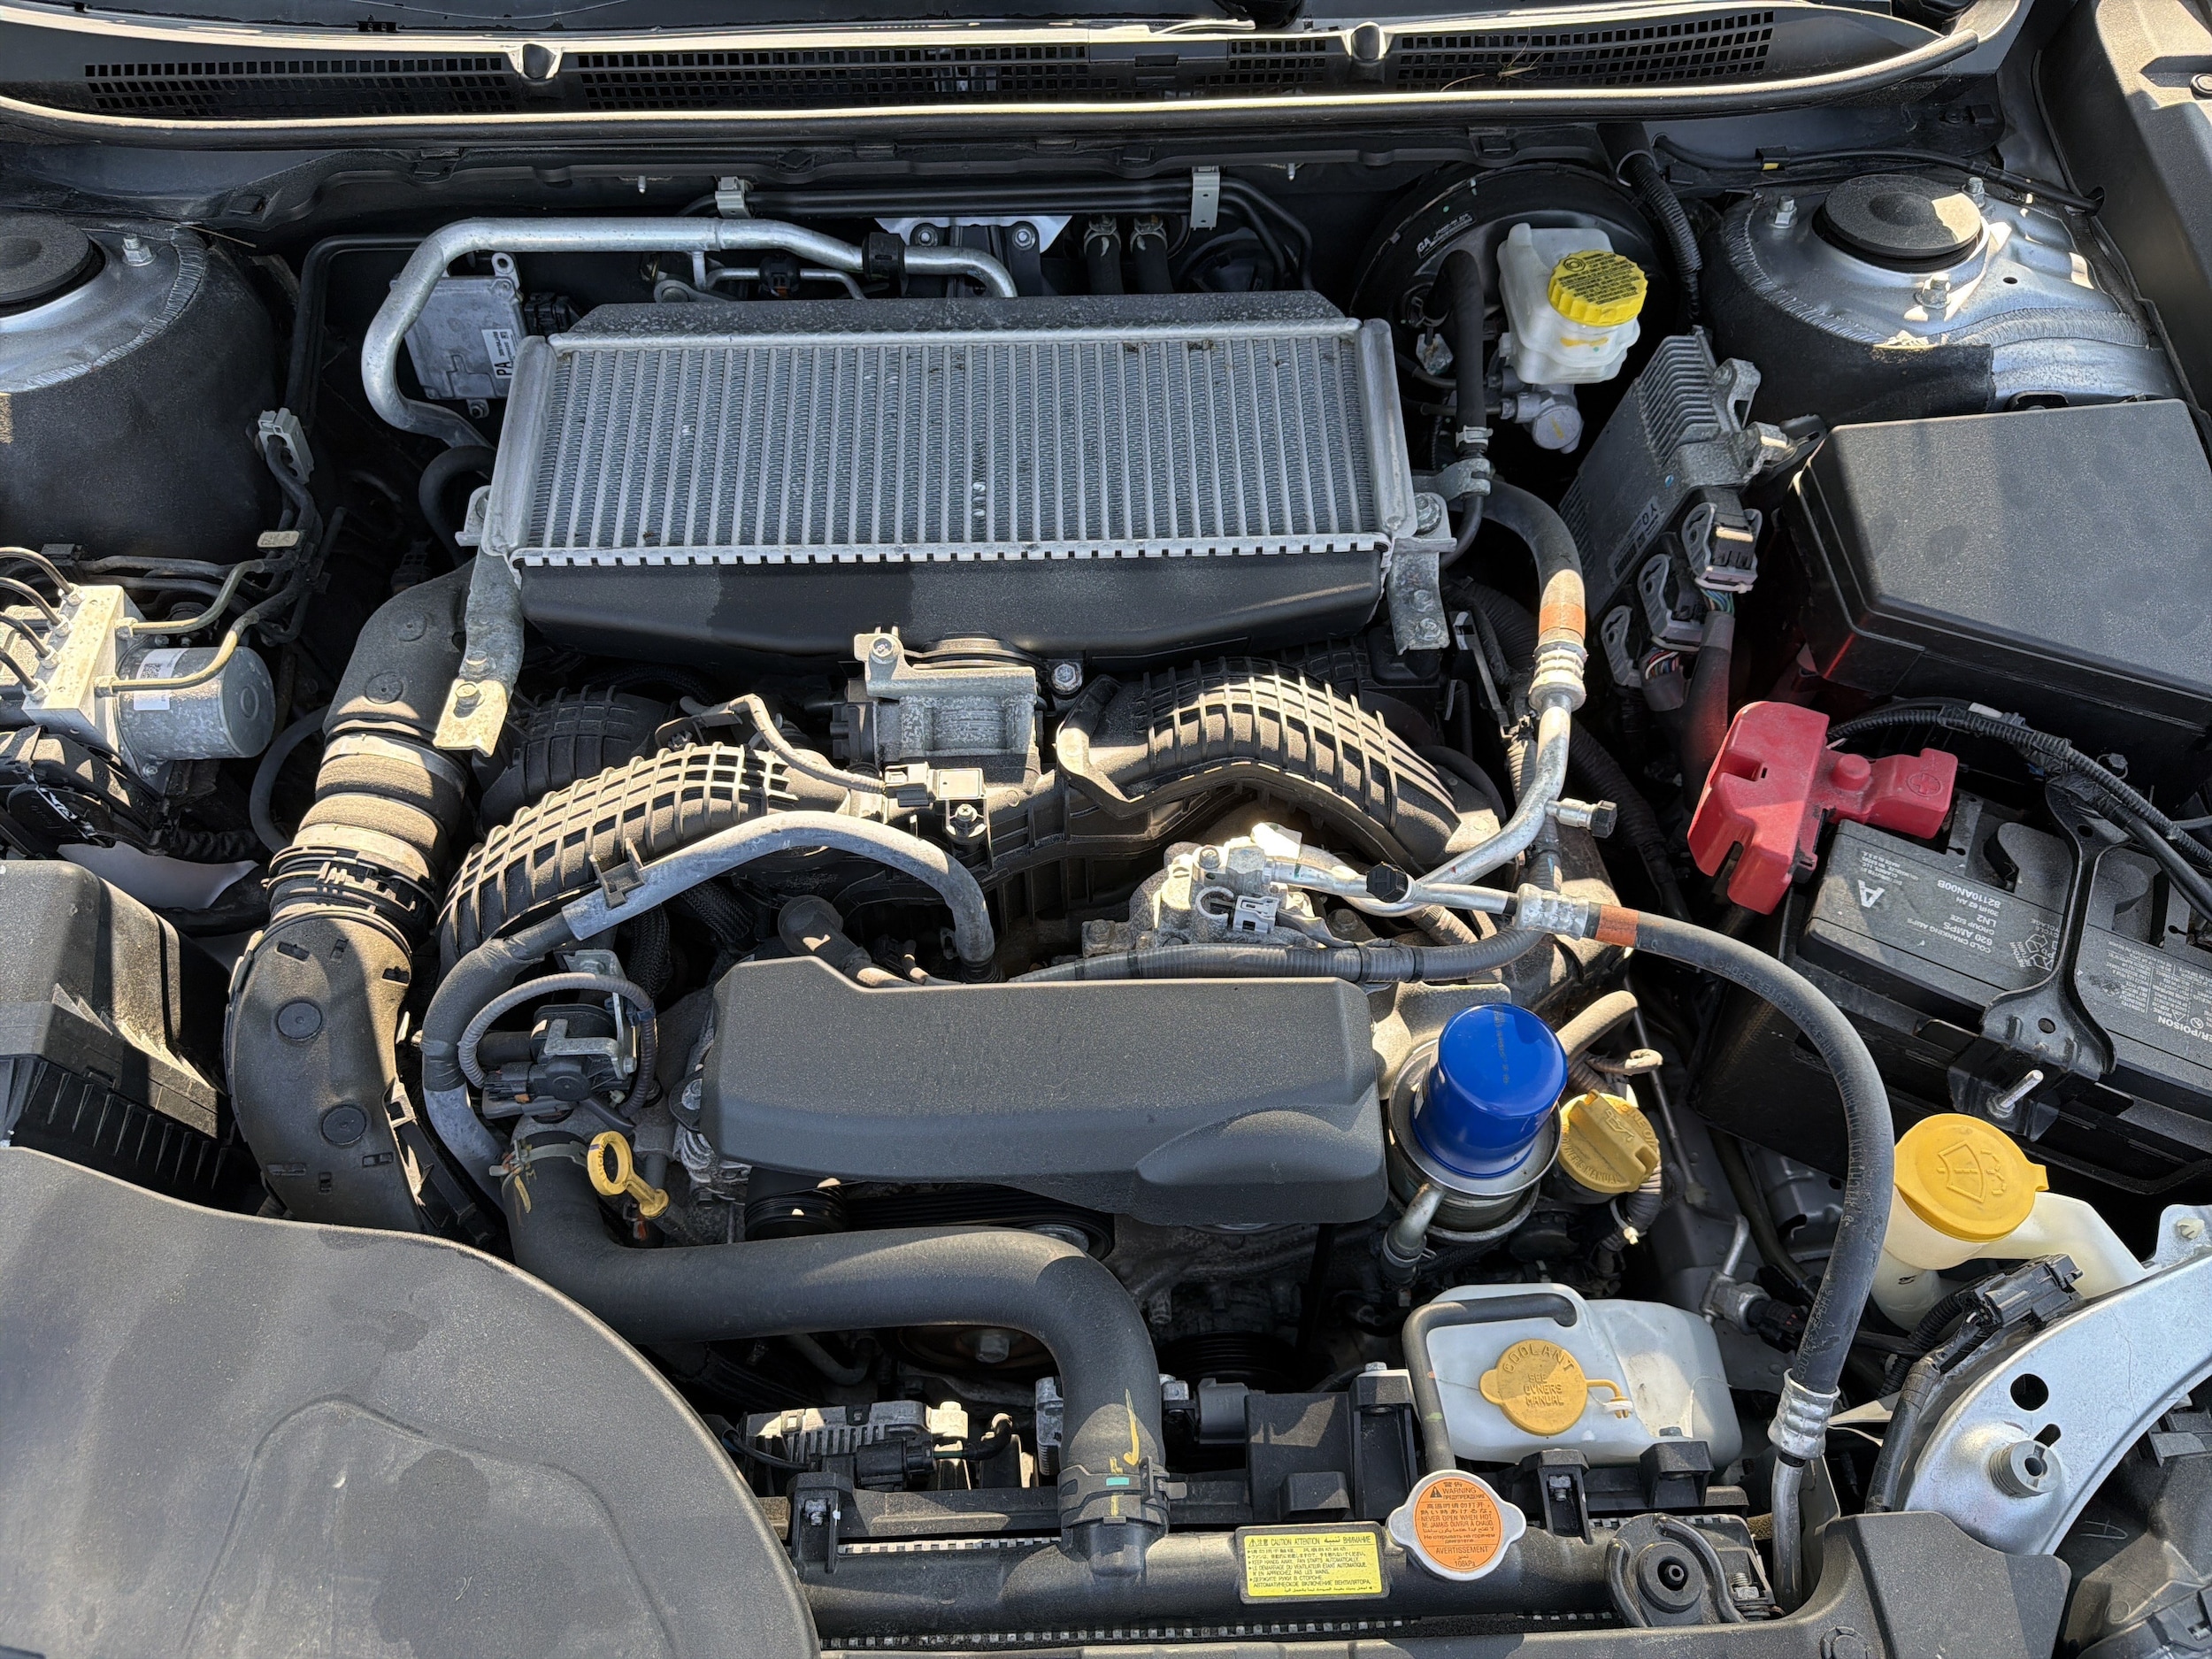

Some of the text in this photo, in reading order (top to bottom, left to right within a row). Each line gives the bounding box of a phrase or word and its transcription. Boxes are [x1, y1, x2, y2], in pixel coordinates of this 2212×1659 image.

[1417, 238, 1431, 252] GA
[495, 362, 512, 375] PA
[1936, 878, 2001, 908] 82110AN00B
[1955, 896, 1968, 905] AH
[1978, 904, 1999, 916] 20HR
[1949, 914, 1995, 935] GROUP SIZE
[1975, 914, 1997, 927] LN2
[2029, 918, 2060, 932] YCLAGE
[1906, 917, 1991, 953] COLD CRANKING AMPS
[1942, 921, 1993, 945] 620 AMPS
[2034, 925, 2058, 937] CYCLE
[1585, 1165, 1621, 1184] MANUAL
[1503, 1344, 1575, 1374] COOLANT
[1528, 1373, 1548, 1384] SEE
[1526, 1394, 1564, 1408] MANUAL
